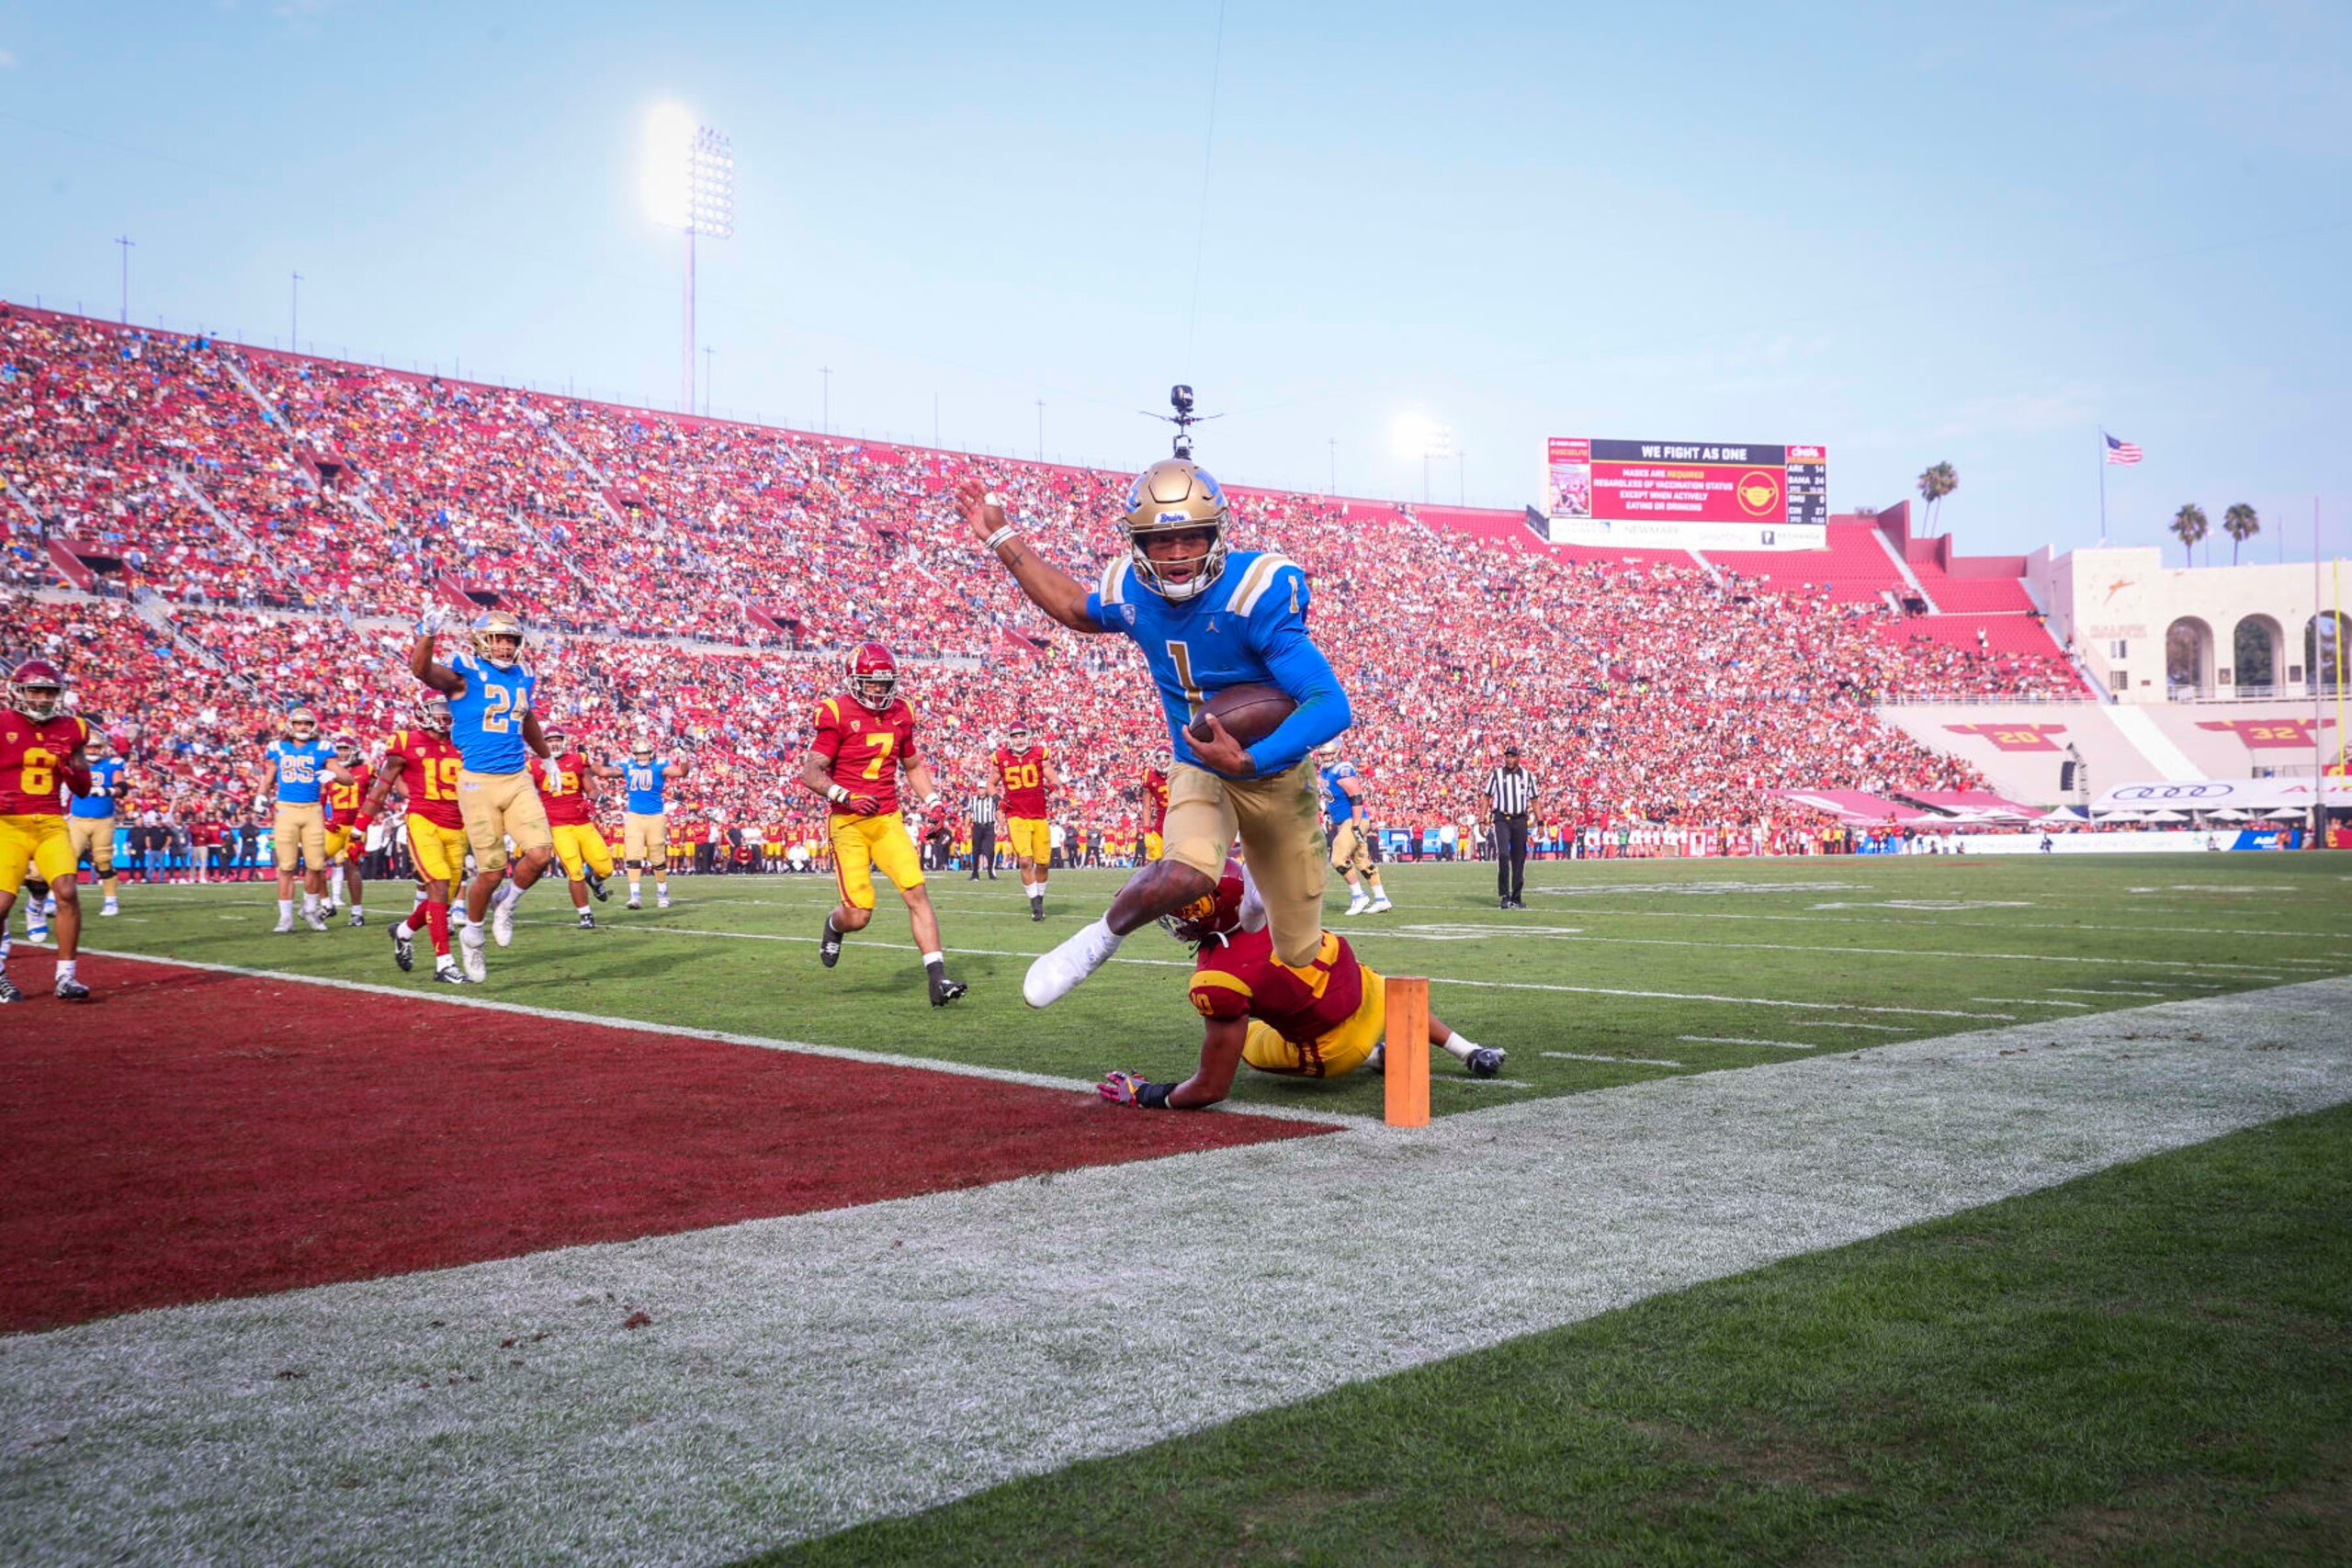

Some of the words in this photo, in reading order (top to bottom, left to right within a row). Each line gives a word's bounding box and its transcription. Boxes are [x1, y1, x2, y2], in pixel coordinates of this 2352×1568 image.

[1642, 446, 1661, 458] WE
[1664, 446, 1701, 459] FIGHT
[1702, 447, 1720, 459] AS
[1722, 448, 1747, 460] ONE
[1593, 479, 1643, 488] REGARDLESS
[1644, 480, 1655, 489] OF
[1655, 480, 1704, 490] VACCINATION
[1705, 481, 1734, 491] STATUS
[1623, 468, 1650, 477] MASKS
[1650, 468, 1666, 478] ARE
[1667, 469, 1704, 479] REQUIRED
[1620, 491, 1649, 499] EXCEPT
[1649, 491, 1673, 500] WHEN
[1673, 491, 1708, 501] ACTIVELY
[1625, 502, 1653, 511] EATING
[1654, 502, 1666, 511] OR
[1666, 502, 1702, 512] DRINKING
[1288, 575, 1299, 614] 1
[1166, 640, 1205, 718] 1
[482, 683, 528, 734] 24
[1993, 731, 2041, 743] 20
[2248, 728, 2298, 739] 32
[862, 732, 894, 779] 7
[21, 747, 57, 795] 8
[280, 755, 315, 784] 85
[422, 758, 462, 800] 19
[628, 769, 653, 791] 70
[1004, 763, 1038, 790] 50
[332, 782, 359, 809] 21
